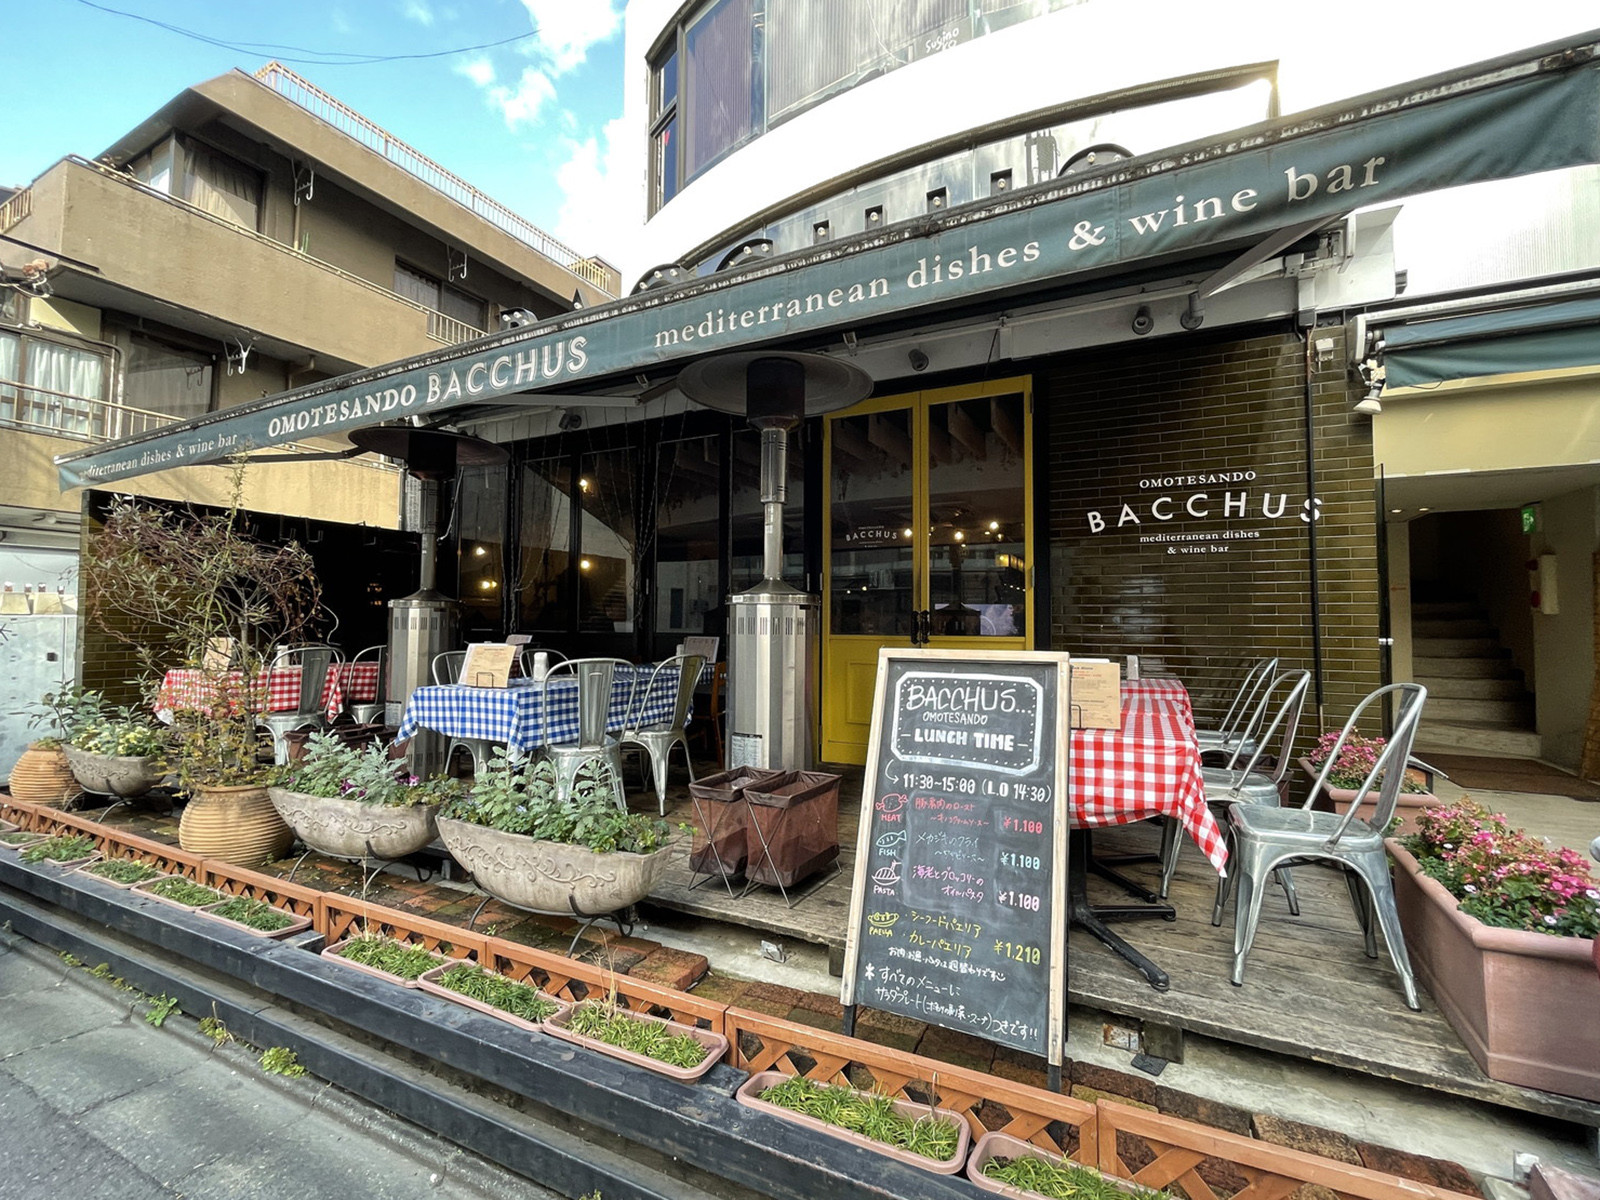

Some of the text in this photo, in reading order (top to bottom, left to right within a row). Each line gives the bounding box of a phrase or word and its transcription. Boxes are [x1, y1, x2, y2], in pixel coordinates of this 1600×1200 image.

[925, 27, 960, 54] Sugino
[268, 156, 1386, 439] OMOTESANDO BACCHUS mediterranean dishes & wine bar
[140, 450, 172, 467] dishes
[175, 443, 185, 458] &
[189, 438, 215, 455] wine
[218, 433, 238, 449] bar
[1139, 470, 1257, 489] OMOTESANDO
[1087, 491, 1323, 534] BACCHUS
[846, 530, 897, 542] BACCHUS
[1139, 530, 1260, 543] mediterranean dishes
[1180, 546, 1207, 554] wine
[1210, 544, 1229, 554] bar
[922, 712, 989, 725] OMOTESANDO
[914, 728, 1015, 751] LUNCH TIME
[1013, 784, 1052, 803] 14:30)
[881, 814, 901, 822] MEAT
[915, 831, 979, 849] メカジキのフライ
[878, 848, 897, 857] FISH
[911, 864, 984, 887] 海老とブロッコリーの
[873, 885, 896, 896] PASTA
[941, 884, 984, 904] オイルパスタ
[911, 910, 982, 939] シーフードパエリア
[909, 929, 972, 959] カレーパエリア
[879, 966, 961, 997] すべてのメニューに
